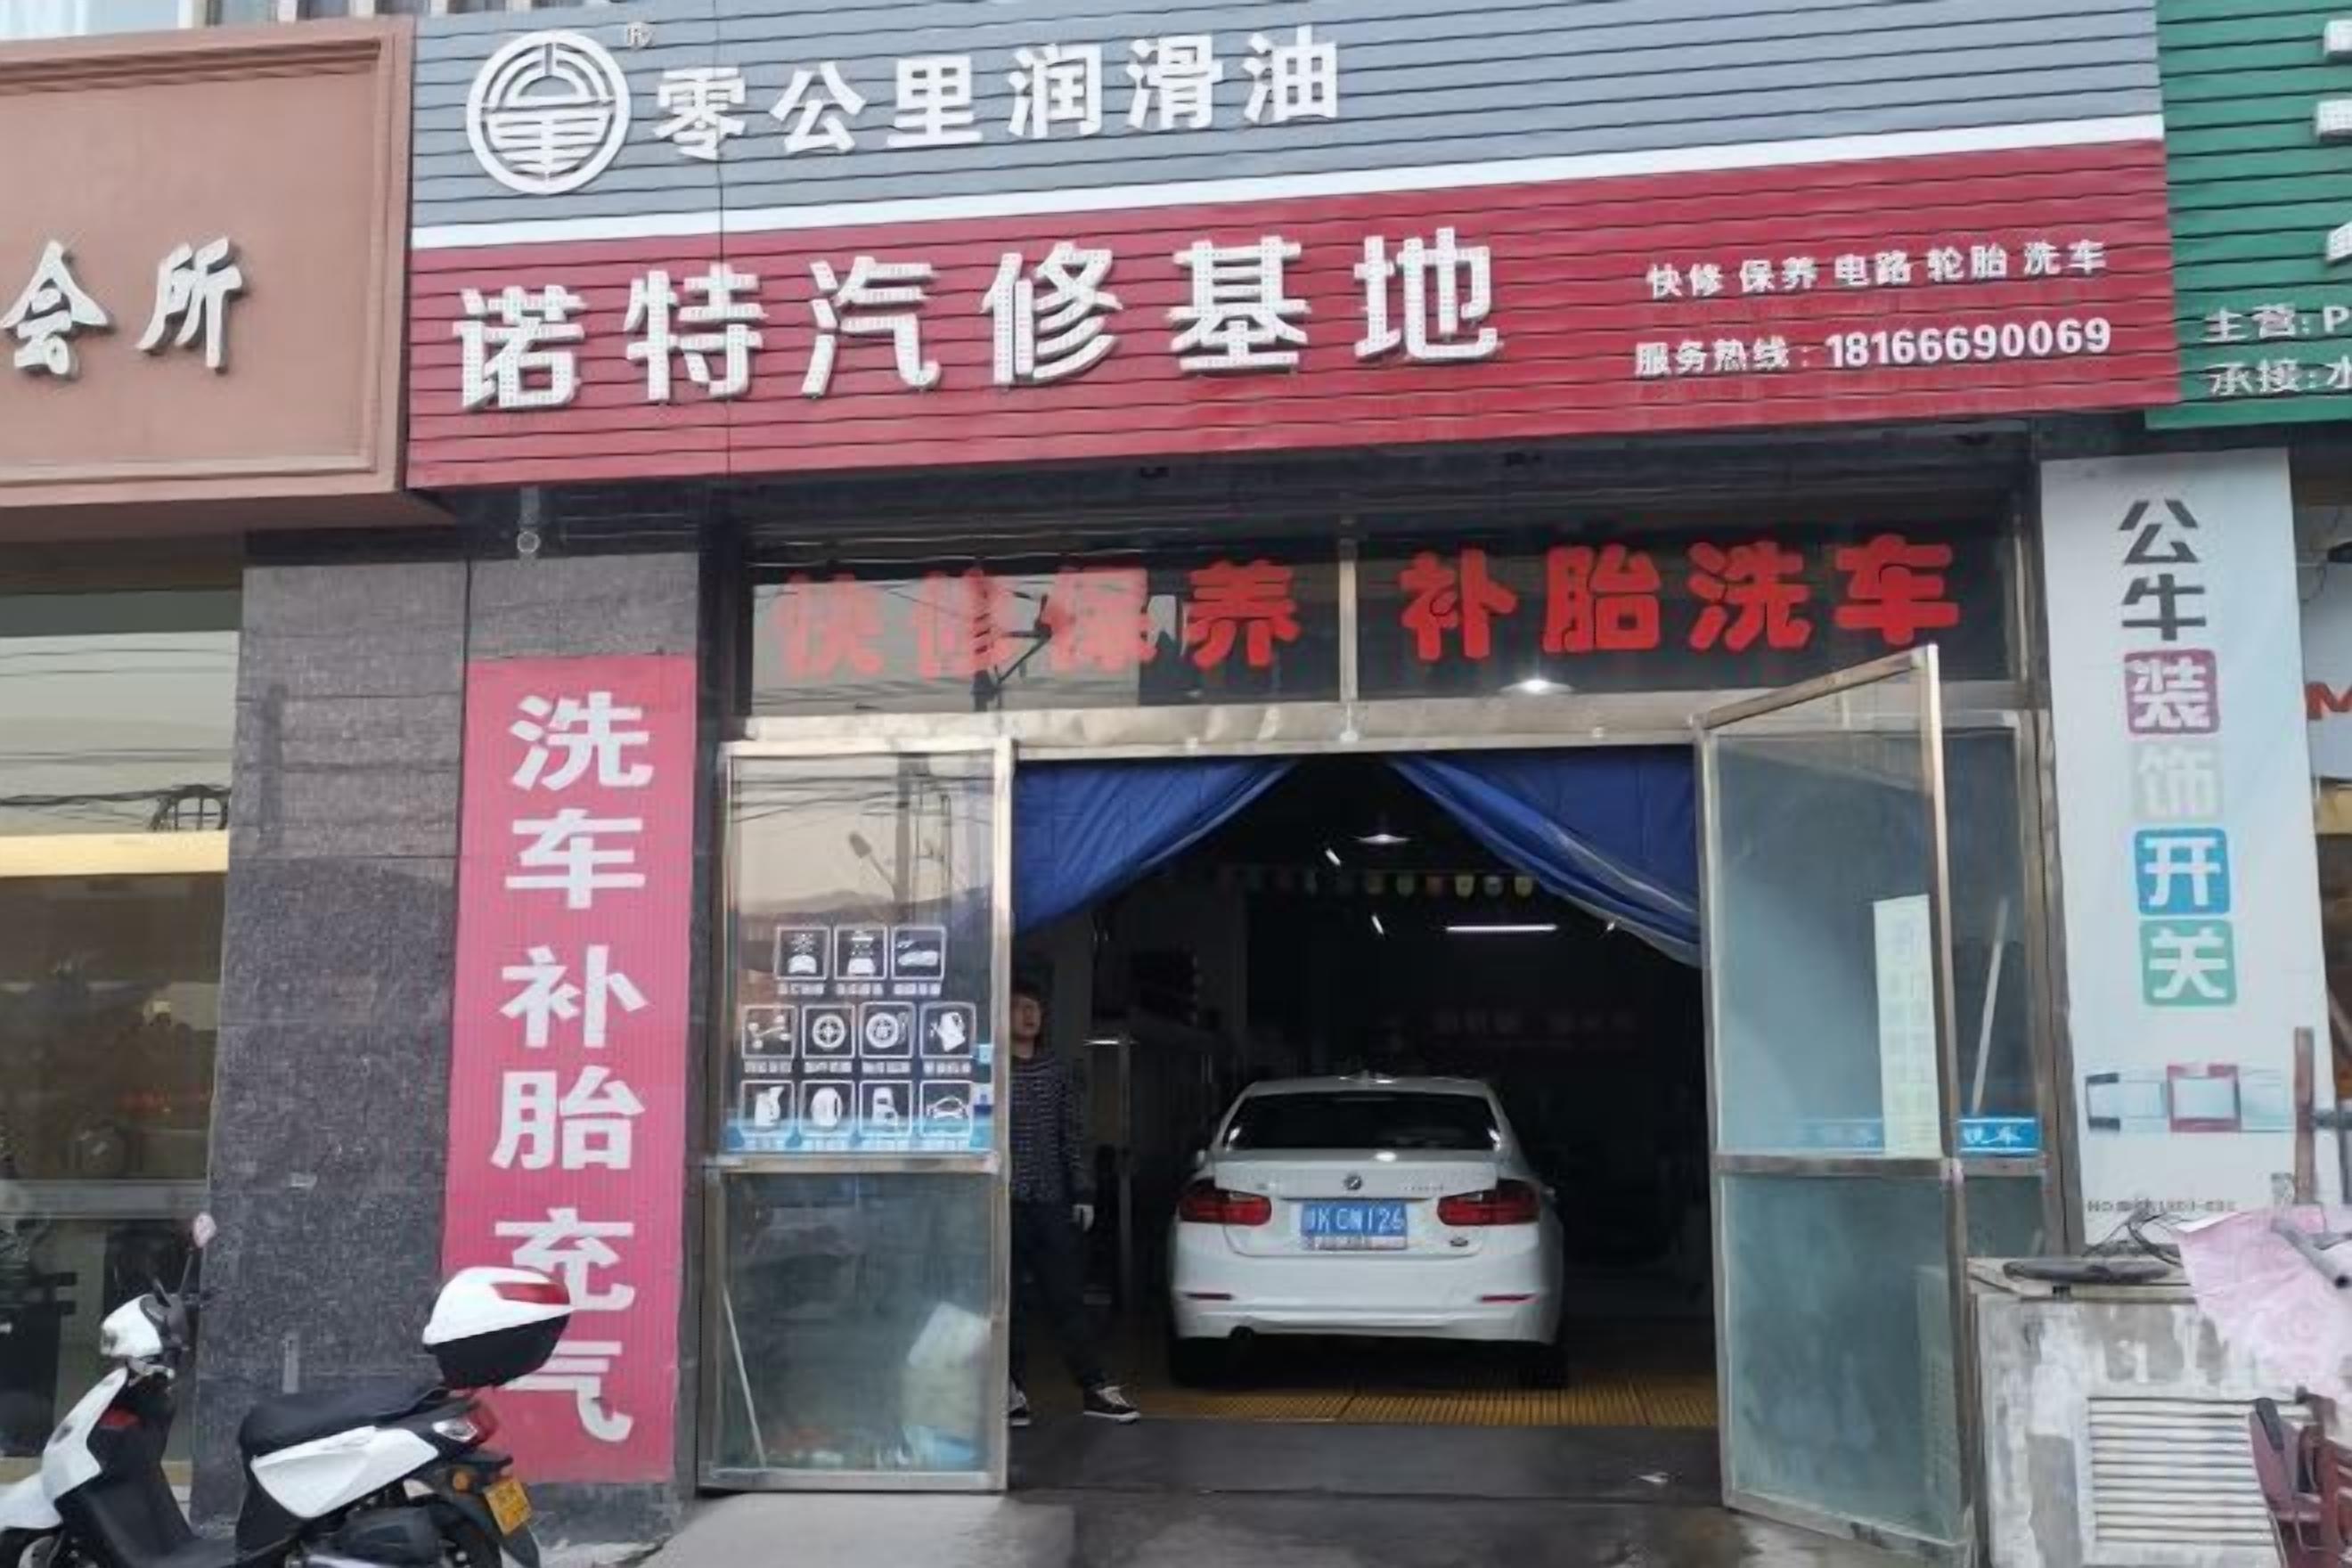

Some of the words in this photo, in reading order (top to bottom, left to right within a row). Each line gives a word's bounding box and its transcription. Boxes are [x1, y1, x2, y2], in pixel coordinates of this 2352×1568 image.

[655, 25, 1340, 160] 零公里润滑油
[2, 235, 241, 378] 会所
[453, 226, 1503, 411] 诺特汽修基地
[1647, 262, 1724, 300] 快修
[1739, 257, 1818, 294] 保养
[1834, 250, 1912, 287] 电路
[1924, 244, 2007, 283] 轮胎
[2023, 239, 2107, 276] 洗车
[1399, 533, 1959, 663] 补胎洗车
[2118, 496, 2228, 1001] 公牛装饰开关
